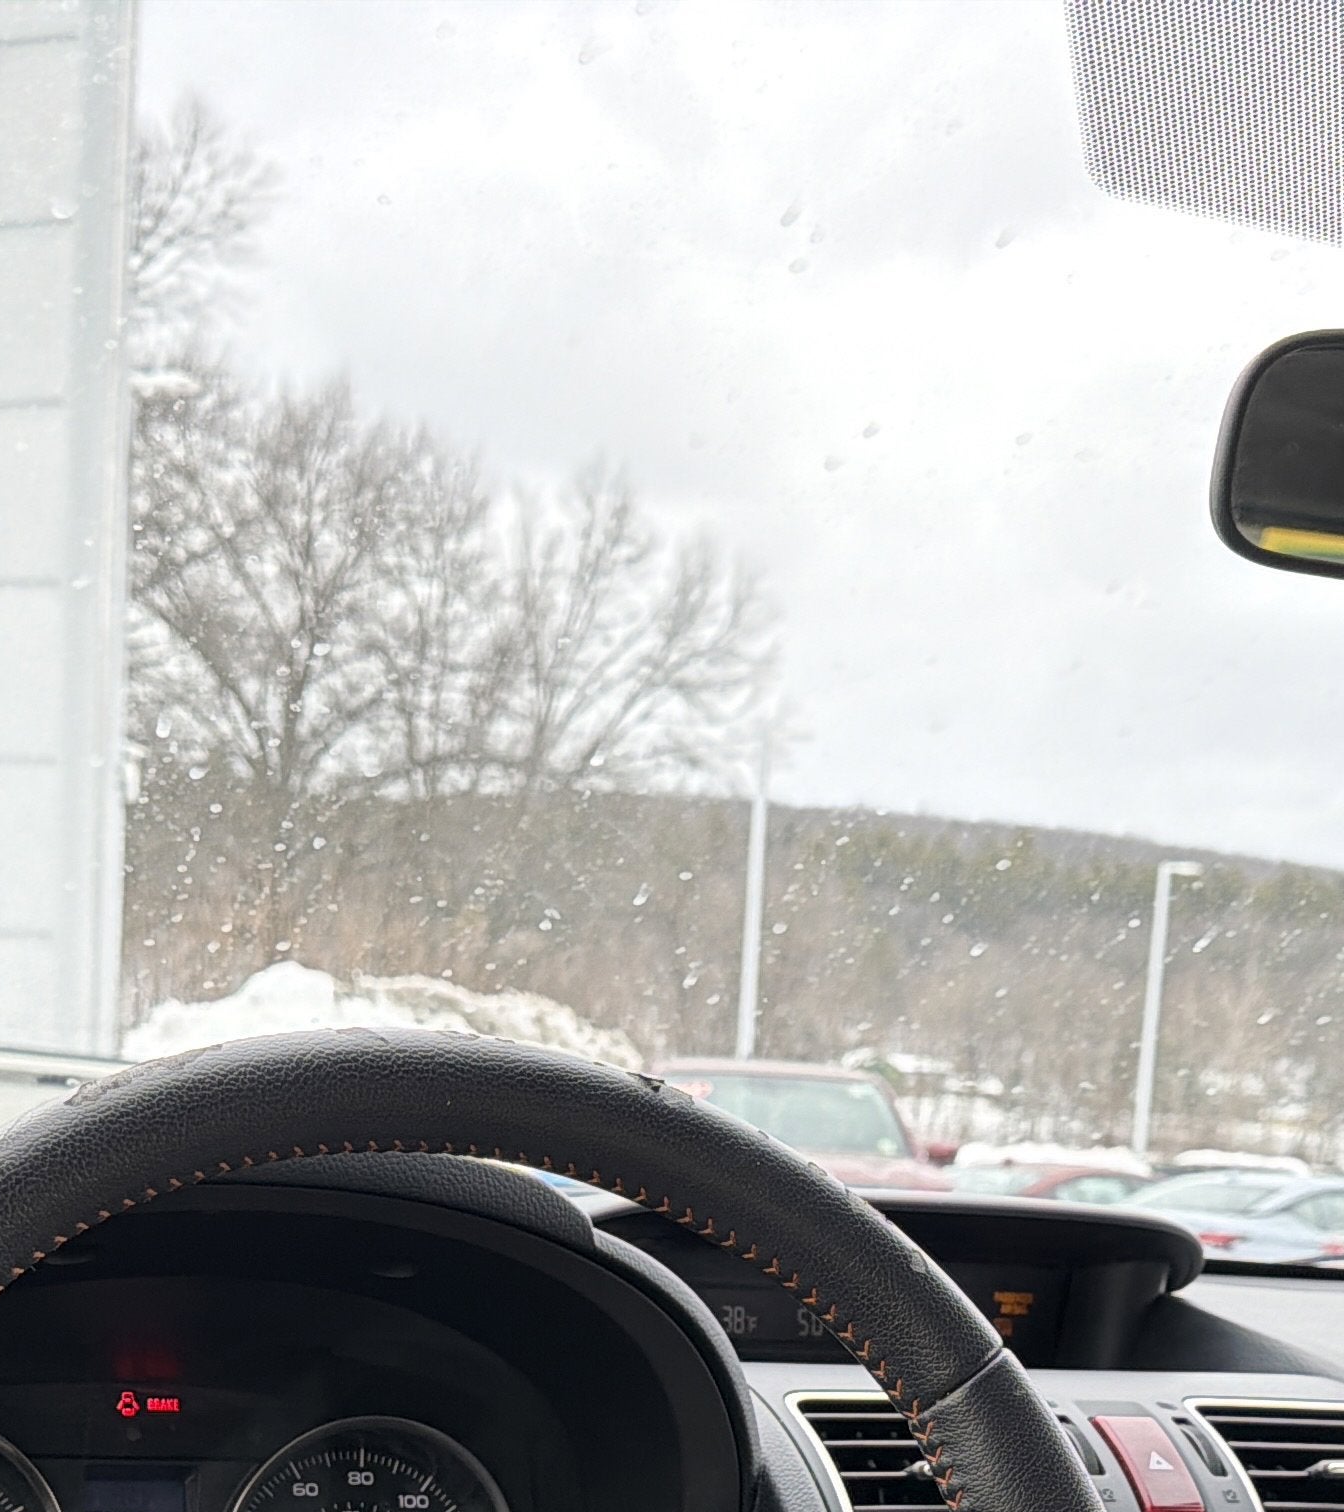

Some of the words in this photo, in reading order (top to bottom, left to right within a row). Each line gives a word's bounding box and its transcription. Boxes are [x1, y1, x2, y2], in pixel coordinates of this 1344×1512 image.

[146, 1397, 181, 1413] BRAKE
[347, 1471, 375, 1486] 80
[292, 1482, 319, 1497] 60
[397, 1494, 430, 1510] 100
